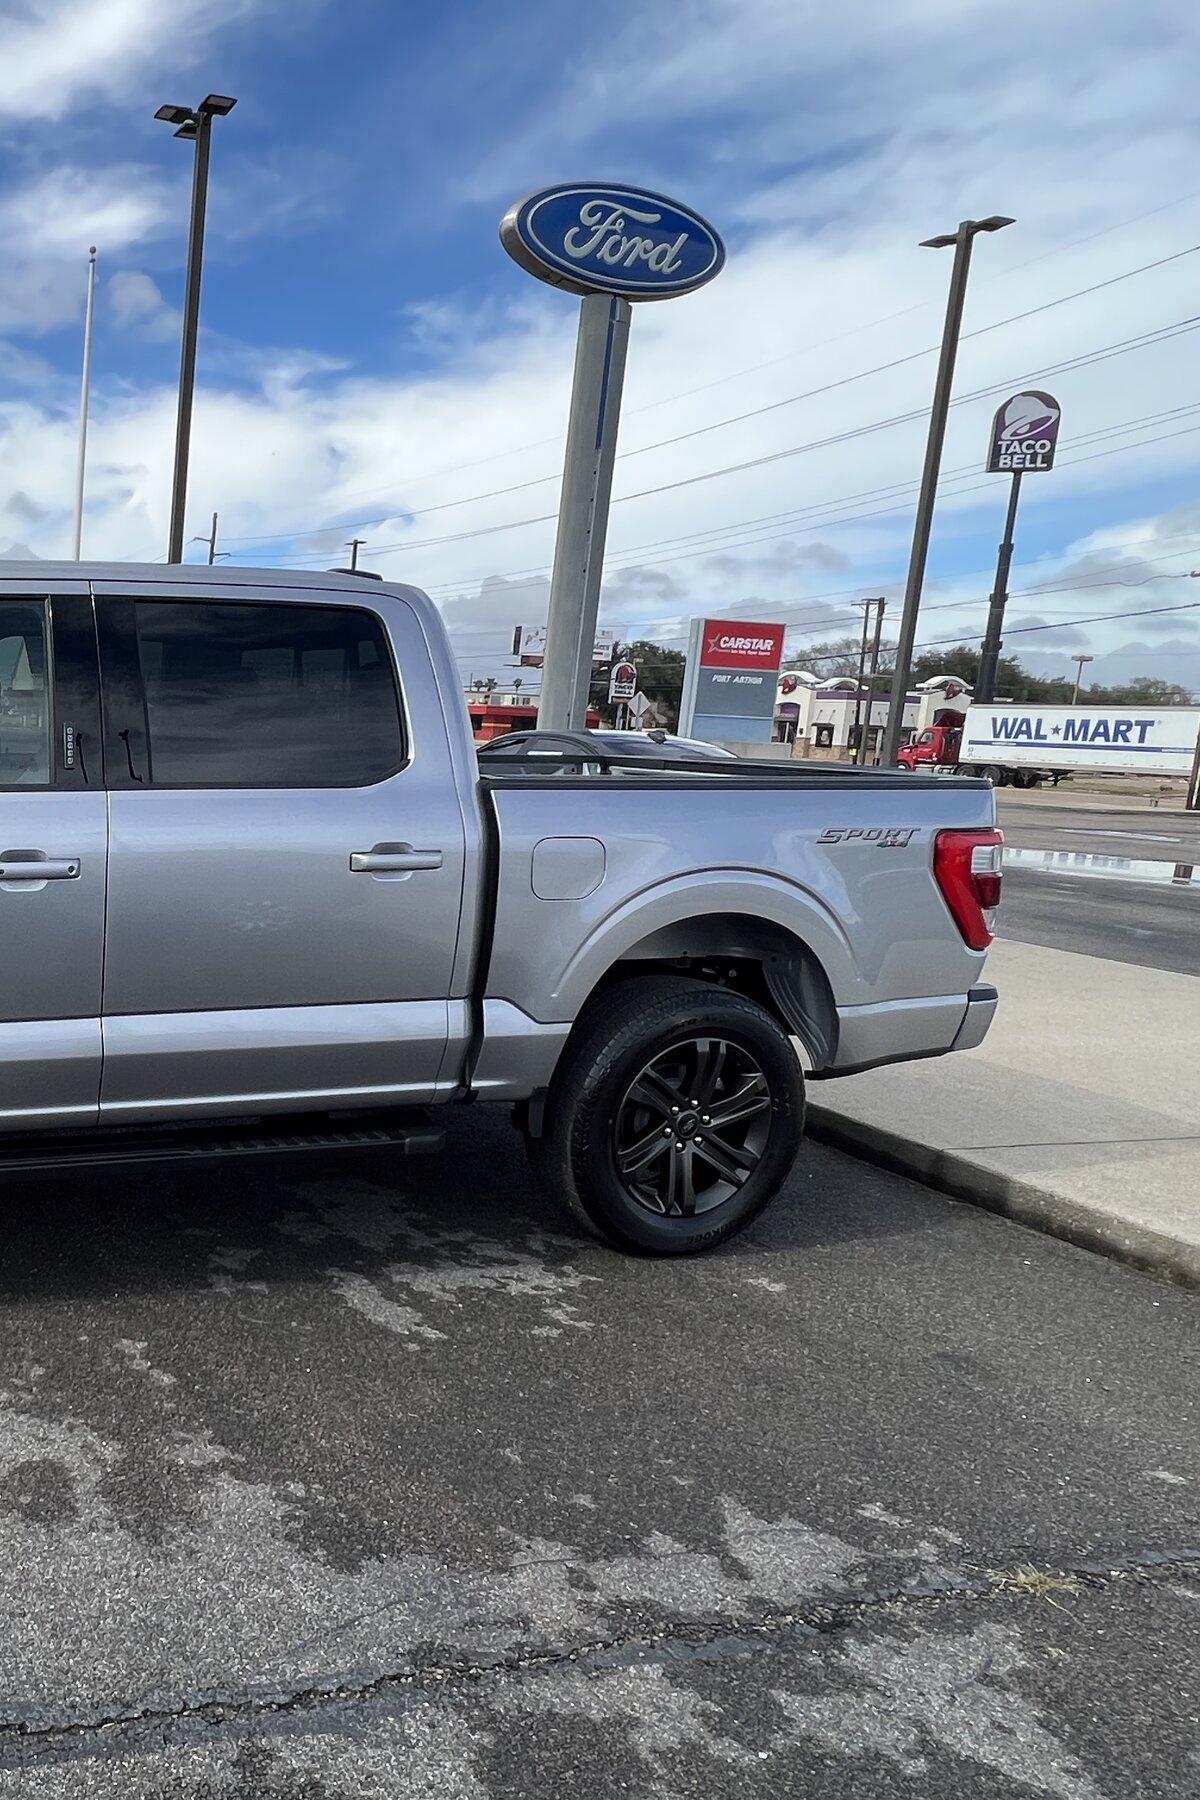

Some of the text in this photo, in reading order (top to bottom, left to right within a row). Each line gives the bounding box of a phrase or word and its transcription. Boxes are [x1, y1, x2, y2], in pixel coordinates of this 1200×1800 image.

[563, 200, 690, 275] Ford
[998, 440, 1051, 454] TACO
[999, 454, 1048, 468] BELL
[720, 636, 774, 651] CARSTAR
[711, 674, 732, 683] PORT
[816, 828, 921, 844] SPORT
